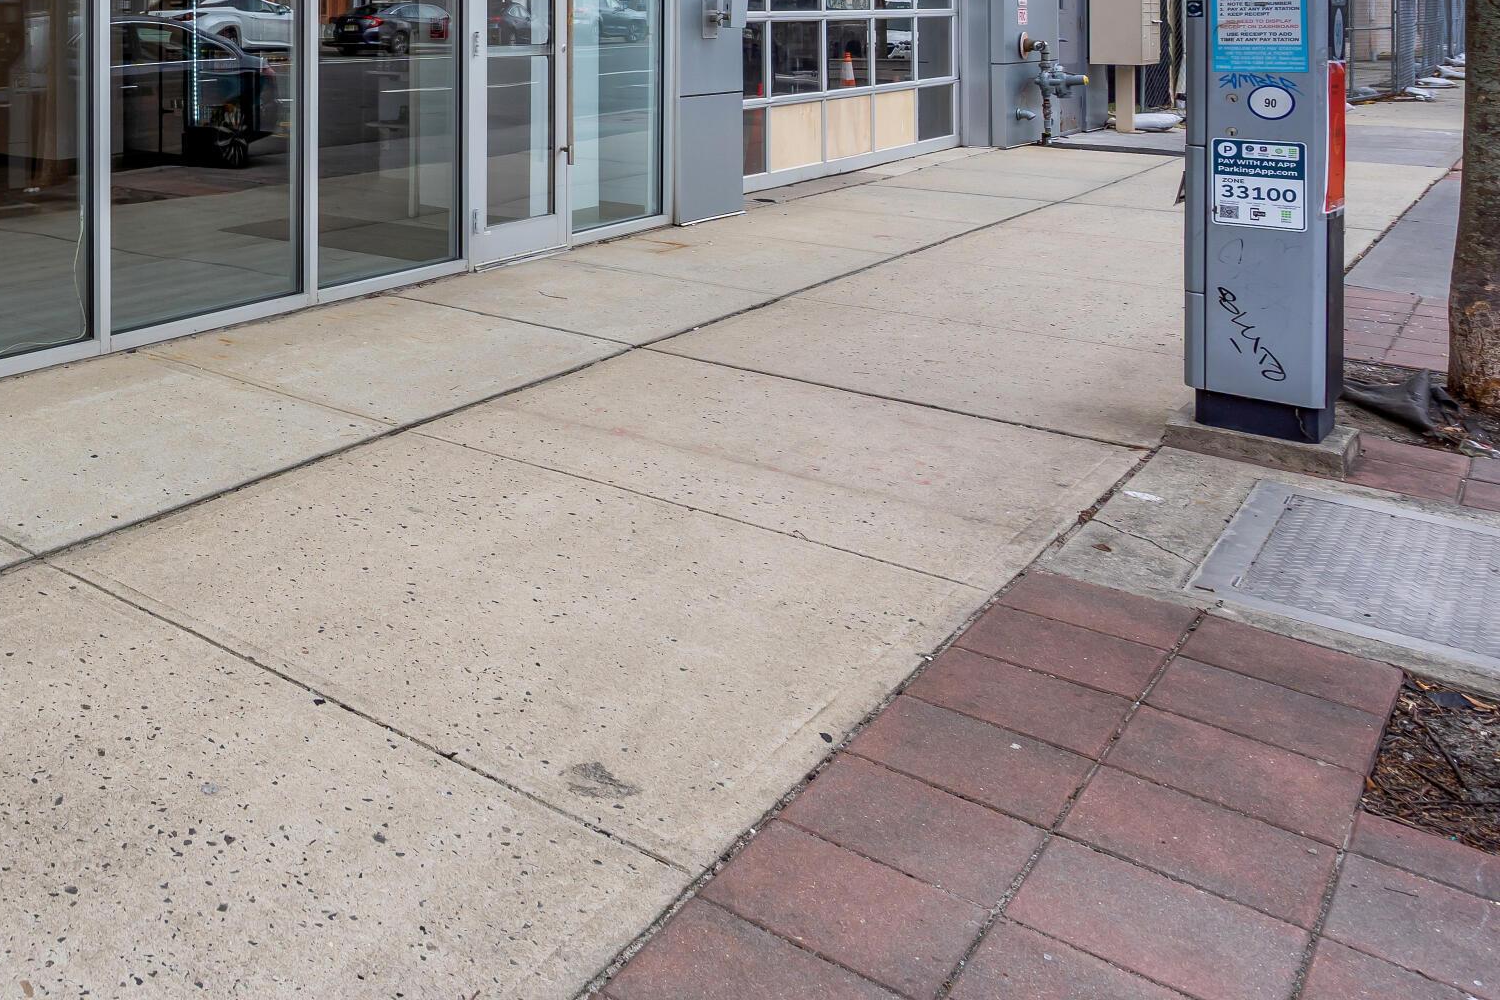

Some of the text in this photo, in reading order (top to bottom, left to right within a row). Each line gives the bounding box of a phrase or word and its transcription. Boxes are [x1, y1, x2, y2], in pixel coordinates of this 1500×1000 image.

[1264, 98, 1277, 108] 90
[1223, 145, 1233, 154] P
[1218, 165, 1298, 177] ParkingApp.com
[1221, 184, 1297, 203] 33100
